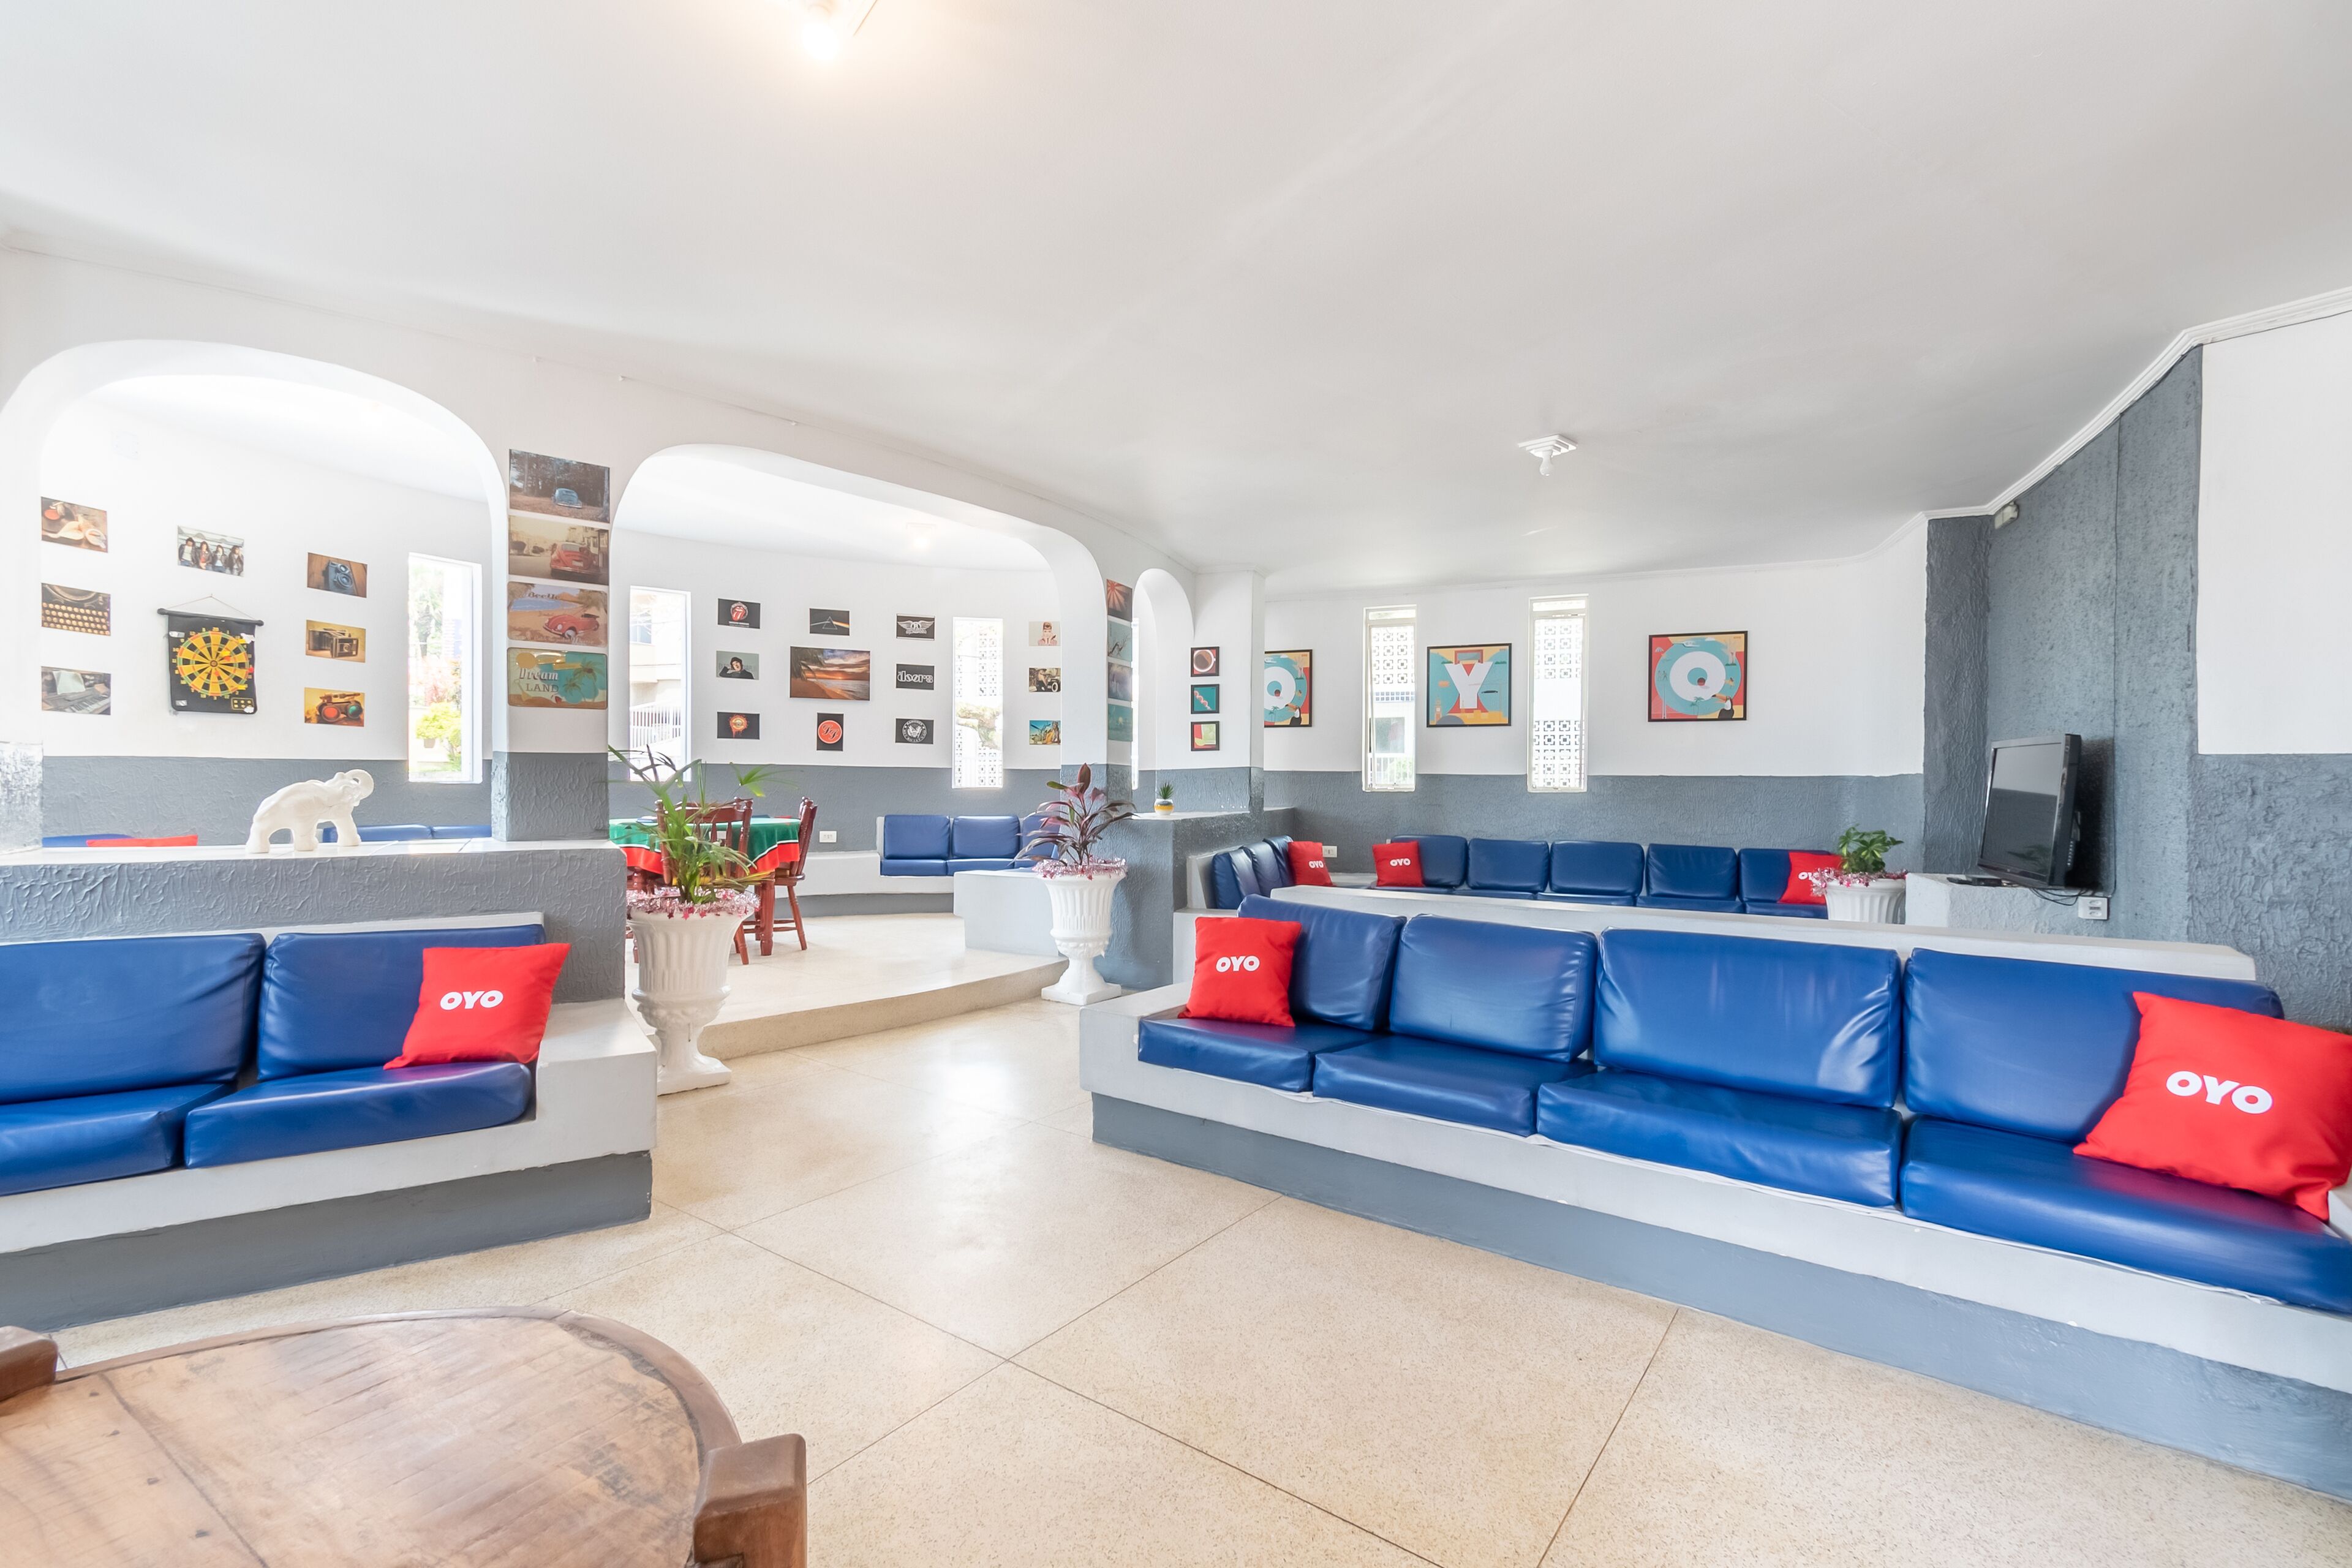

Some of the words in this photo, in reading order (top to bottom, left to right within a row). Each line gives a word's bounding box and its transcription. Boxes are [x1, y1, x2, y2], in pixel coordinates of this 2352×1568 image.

[1443, 660, 1494, 709] Y
[1669, 650, 1727, 703] O
[526, 683, 559, 693] LAND
[1308, 861, 1324, 869] OYO
[1390, 858, 1411, 867] OYO
[1216, 956, 1261, 973] OYO
[440, 990, 504, 1011] OYO
[2166, 1071, 2274, 1114] OYO
